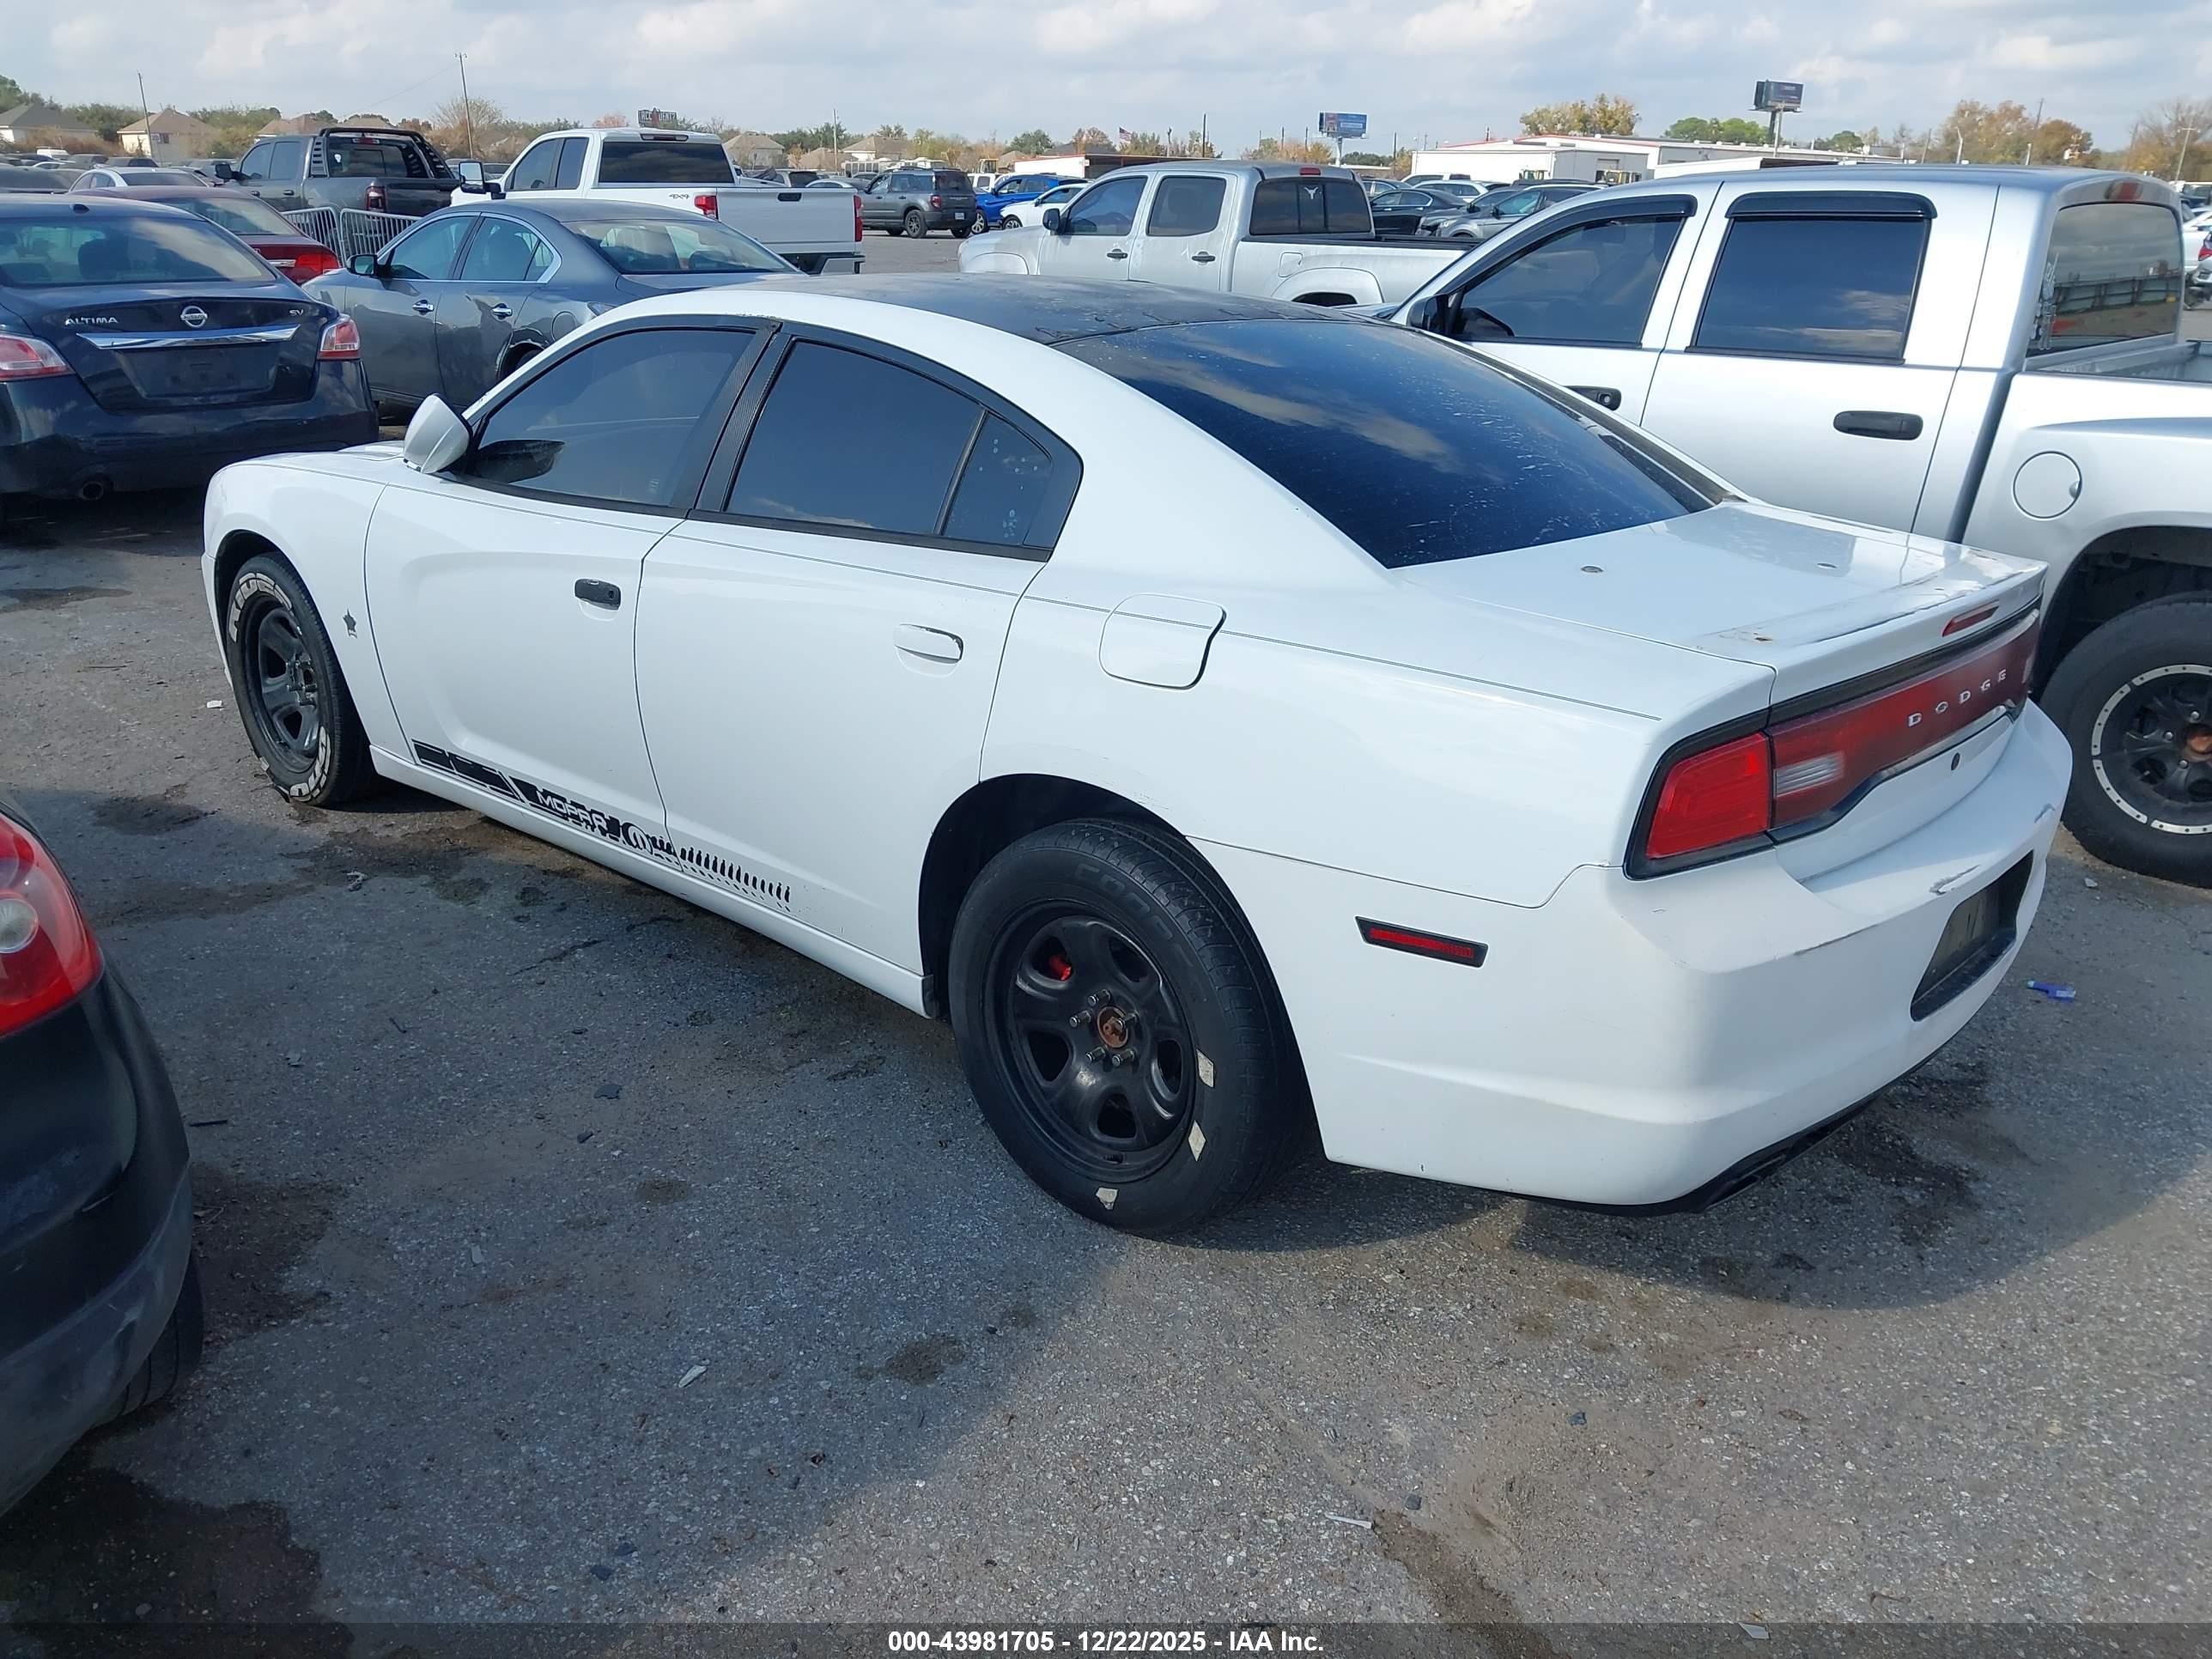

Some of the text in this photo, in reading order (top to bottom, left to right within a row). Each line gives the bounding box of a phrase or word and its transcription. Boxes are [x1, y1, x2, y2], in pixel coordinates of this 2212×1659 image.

[64, 316, 118, 325] ALTIMA
[1908, 669, 2007, 727] DODGE
[536, 790, 608, 832] MOPAR
